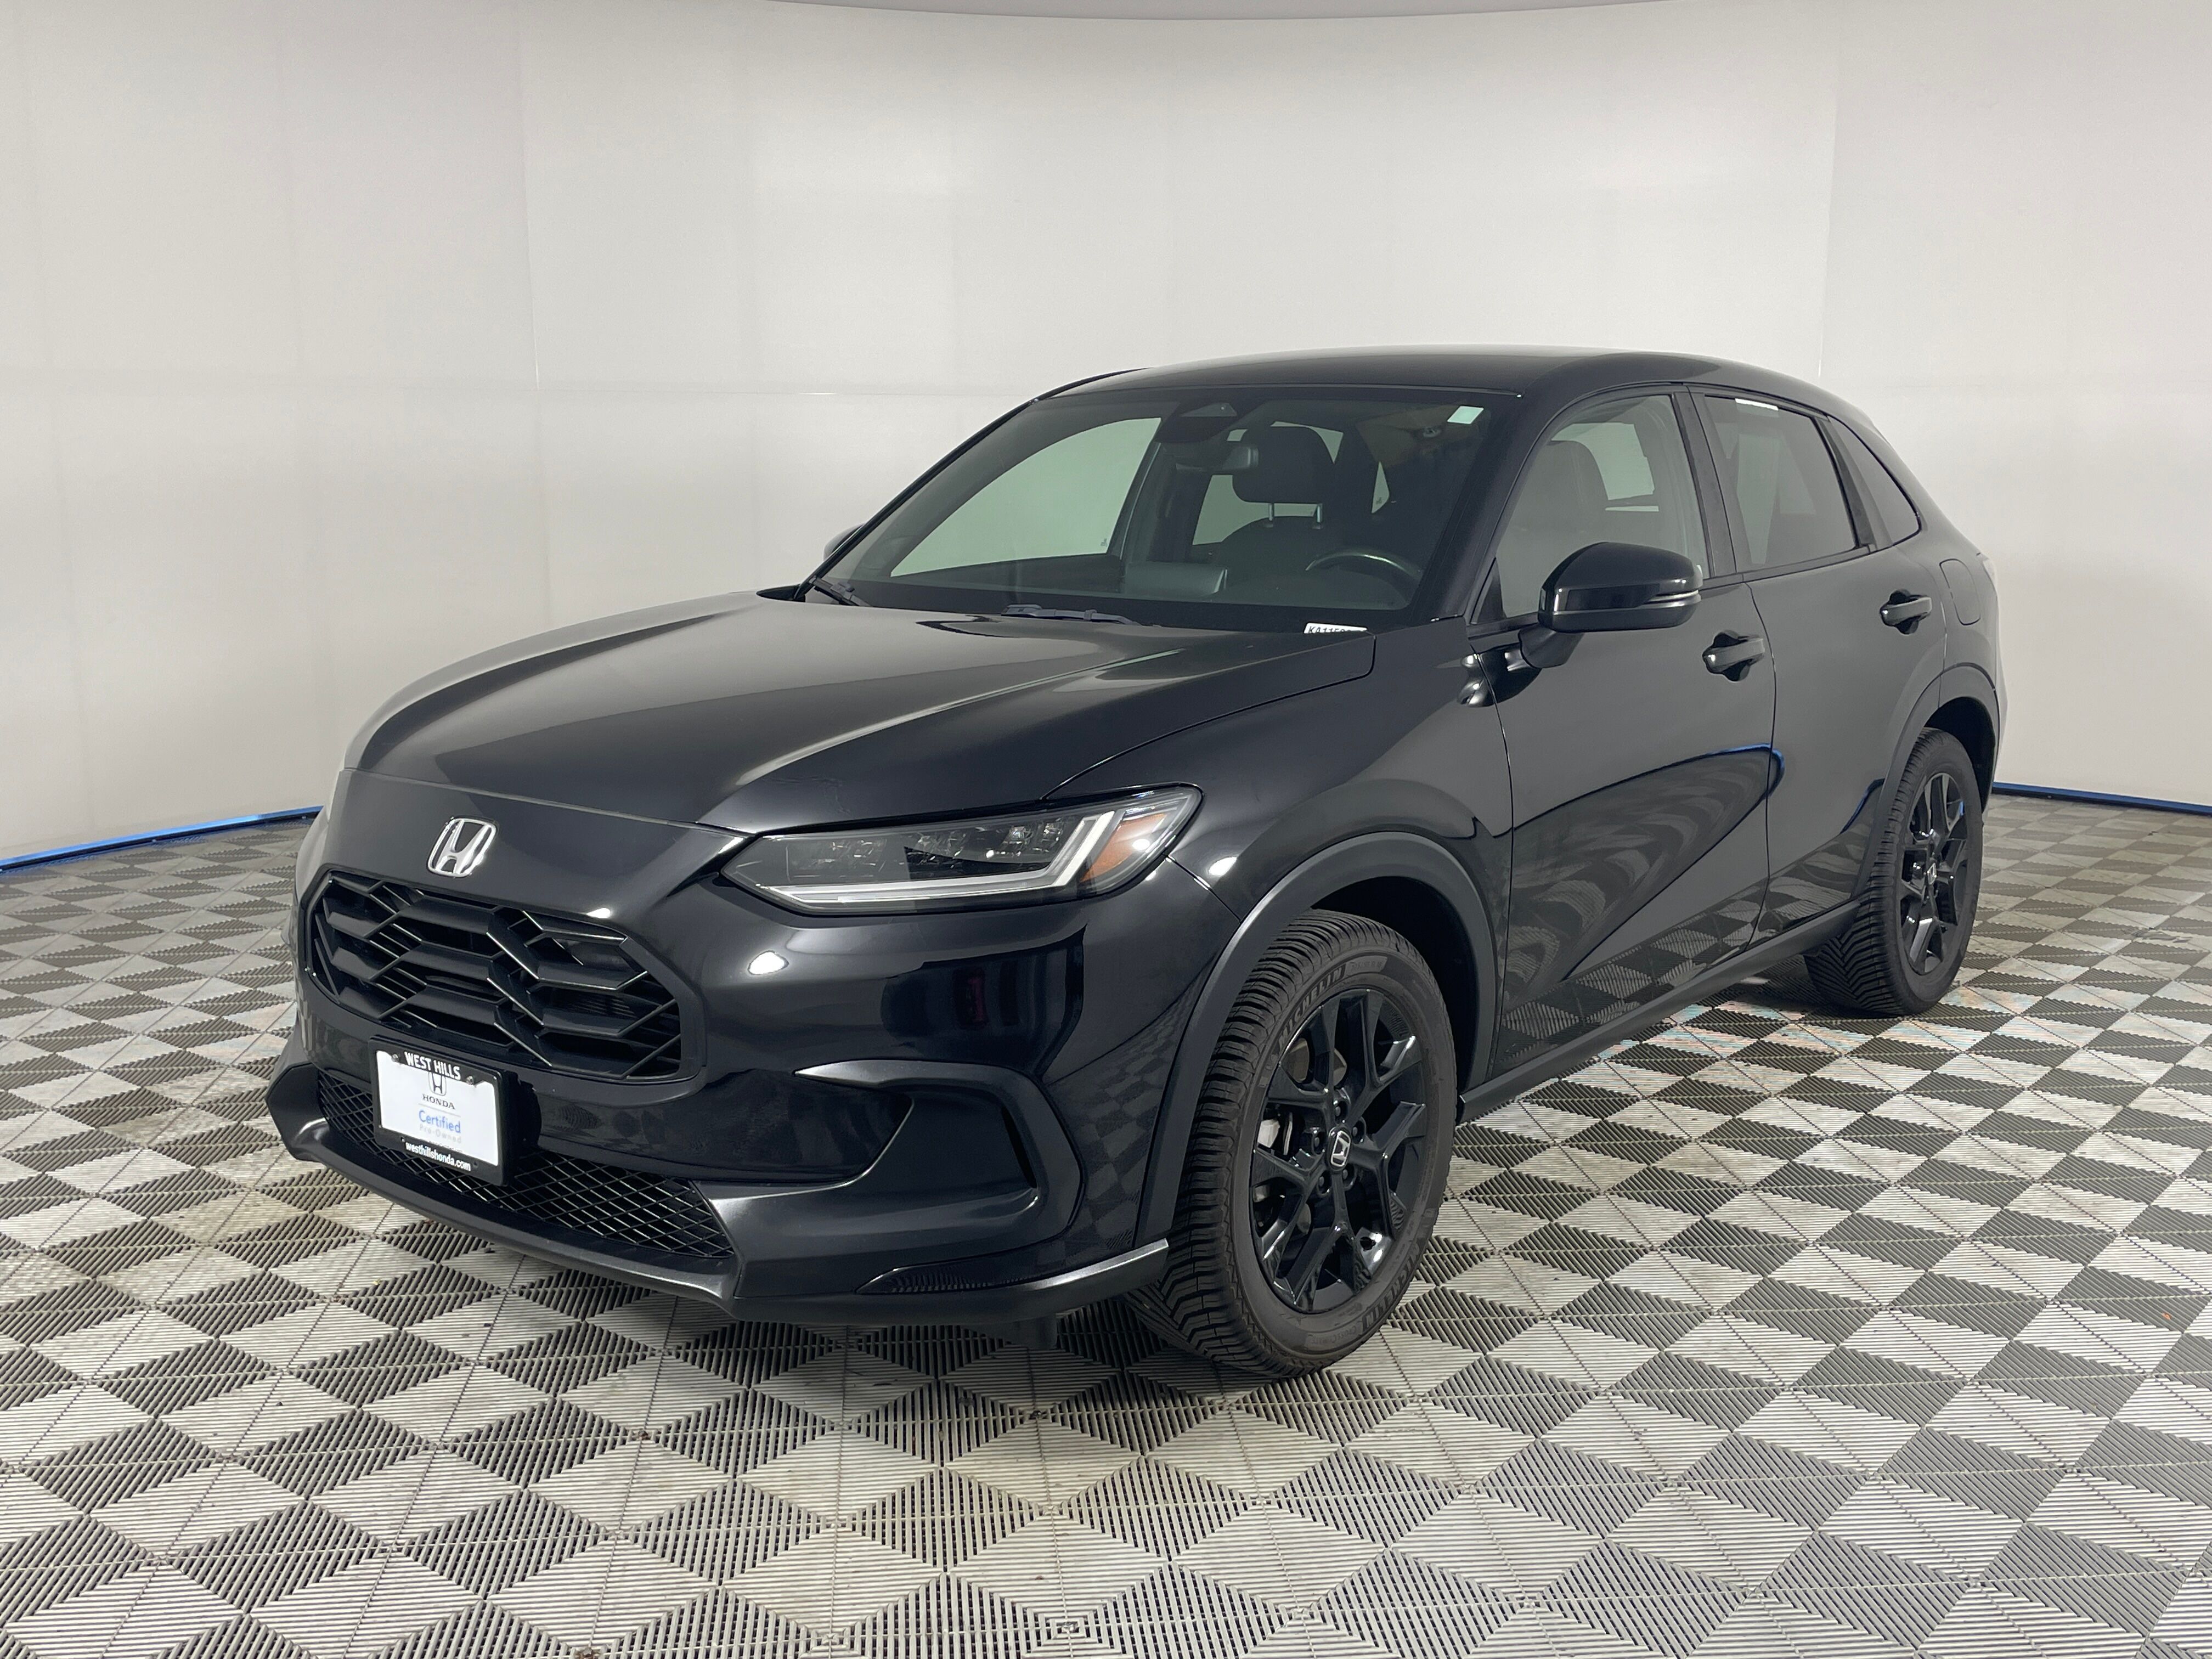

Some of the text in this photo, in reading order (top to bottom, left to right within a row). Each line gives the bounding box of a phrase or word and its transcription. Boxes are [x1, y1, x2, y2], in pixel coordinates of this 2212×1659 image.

[1278, 966, 1342, 1051] MICHELIN
[404, 1051, 461, 1080] WEST HILLS
[422, 1093, 455, 1110] HONDA
[419, 1110, 461, 1133] Certified
[419, 1123, 461, 1144] Pre-Owned
[405, 1142, 471, 1172] westhillshonda.com
